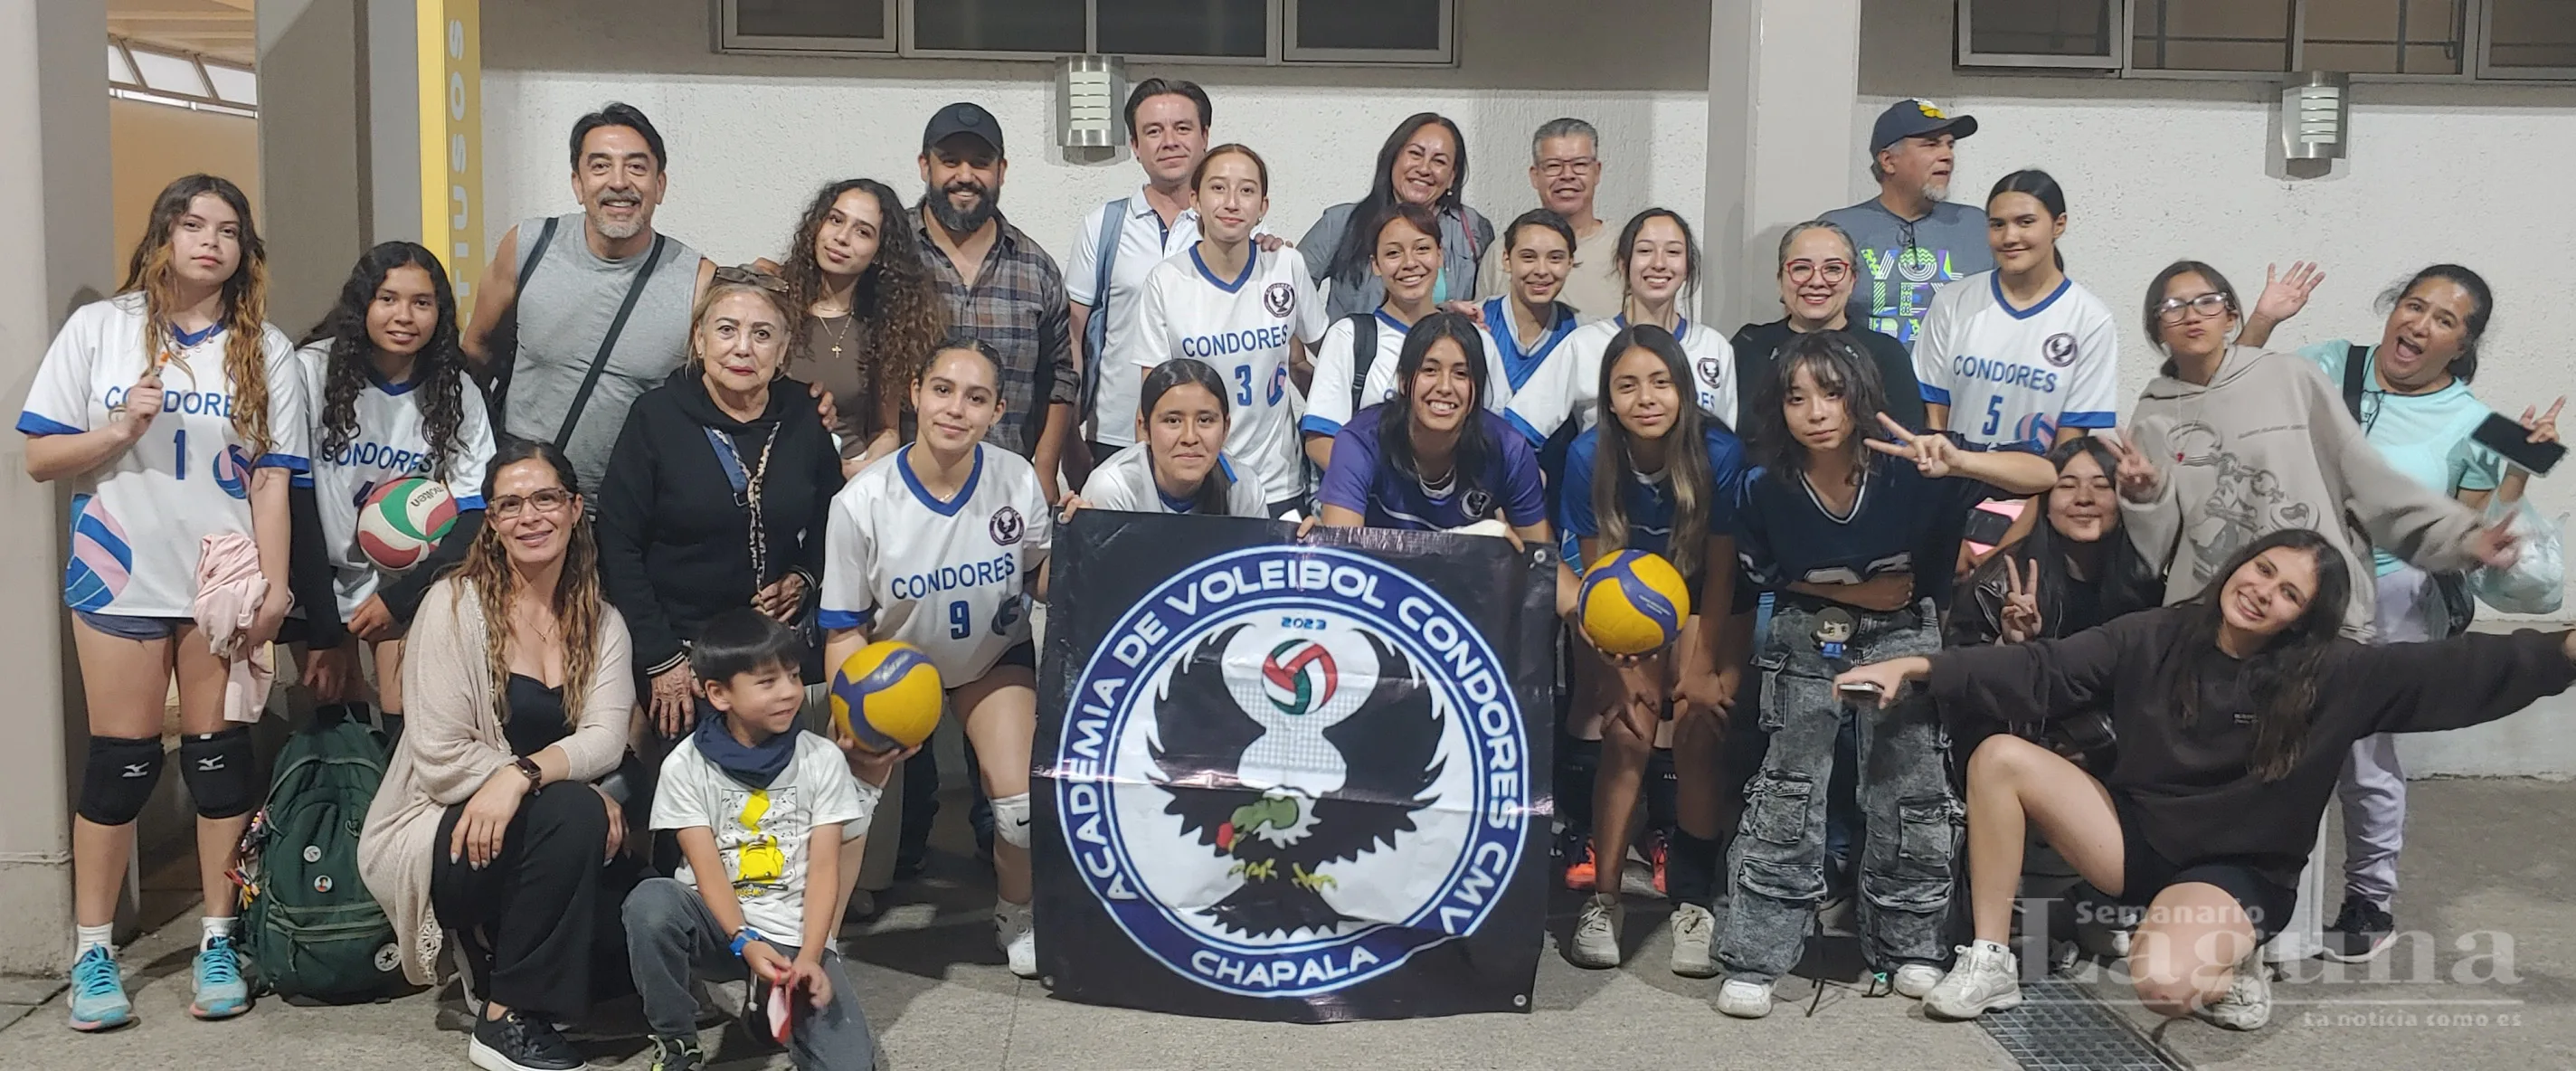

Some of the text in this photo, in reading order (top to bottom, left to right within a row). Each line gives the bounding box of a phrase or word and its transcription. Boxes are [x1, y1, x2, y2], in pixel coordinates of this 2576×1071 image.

[449, 19, 471, 344] TIUSOS
[1861, 247, 1964, 281] VOL
[1872, 281, 1945, 316] LE
[1182, 324, 1288, 357] CONDORES
[1235, 365, 1253, 406] 3
[1954, 355, 2058, 393] CONDORES
[105, 386, 238, 419] CDORE
[1982, 394, 2003, 435] 5
[173, 430, 185, 480] 1
[411, 486, 444, 507] molten
[891, 553, 1015, 600] CONDORES
[1165, 559, 1386, 615] VOLEIBOL
[950, 600, 971, 640] 9
[1113, 611, 1169, 668] DE
[1282, 617, 1327, 630] 2023
[1398, 596, 1519, 830] CONDORES
[1068, 678, 1139, 899] ACADEMIA
[1440, 841, 1508, 934] CMV
[1192, 945, 1379, 987] CHAPALA
